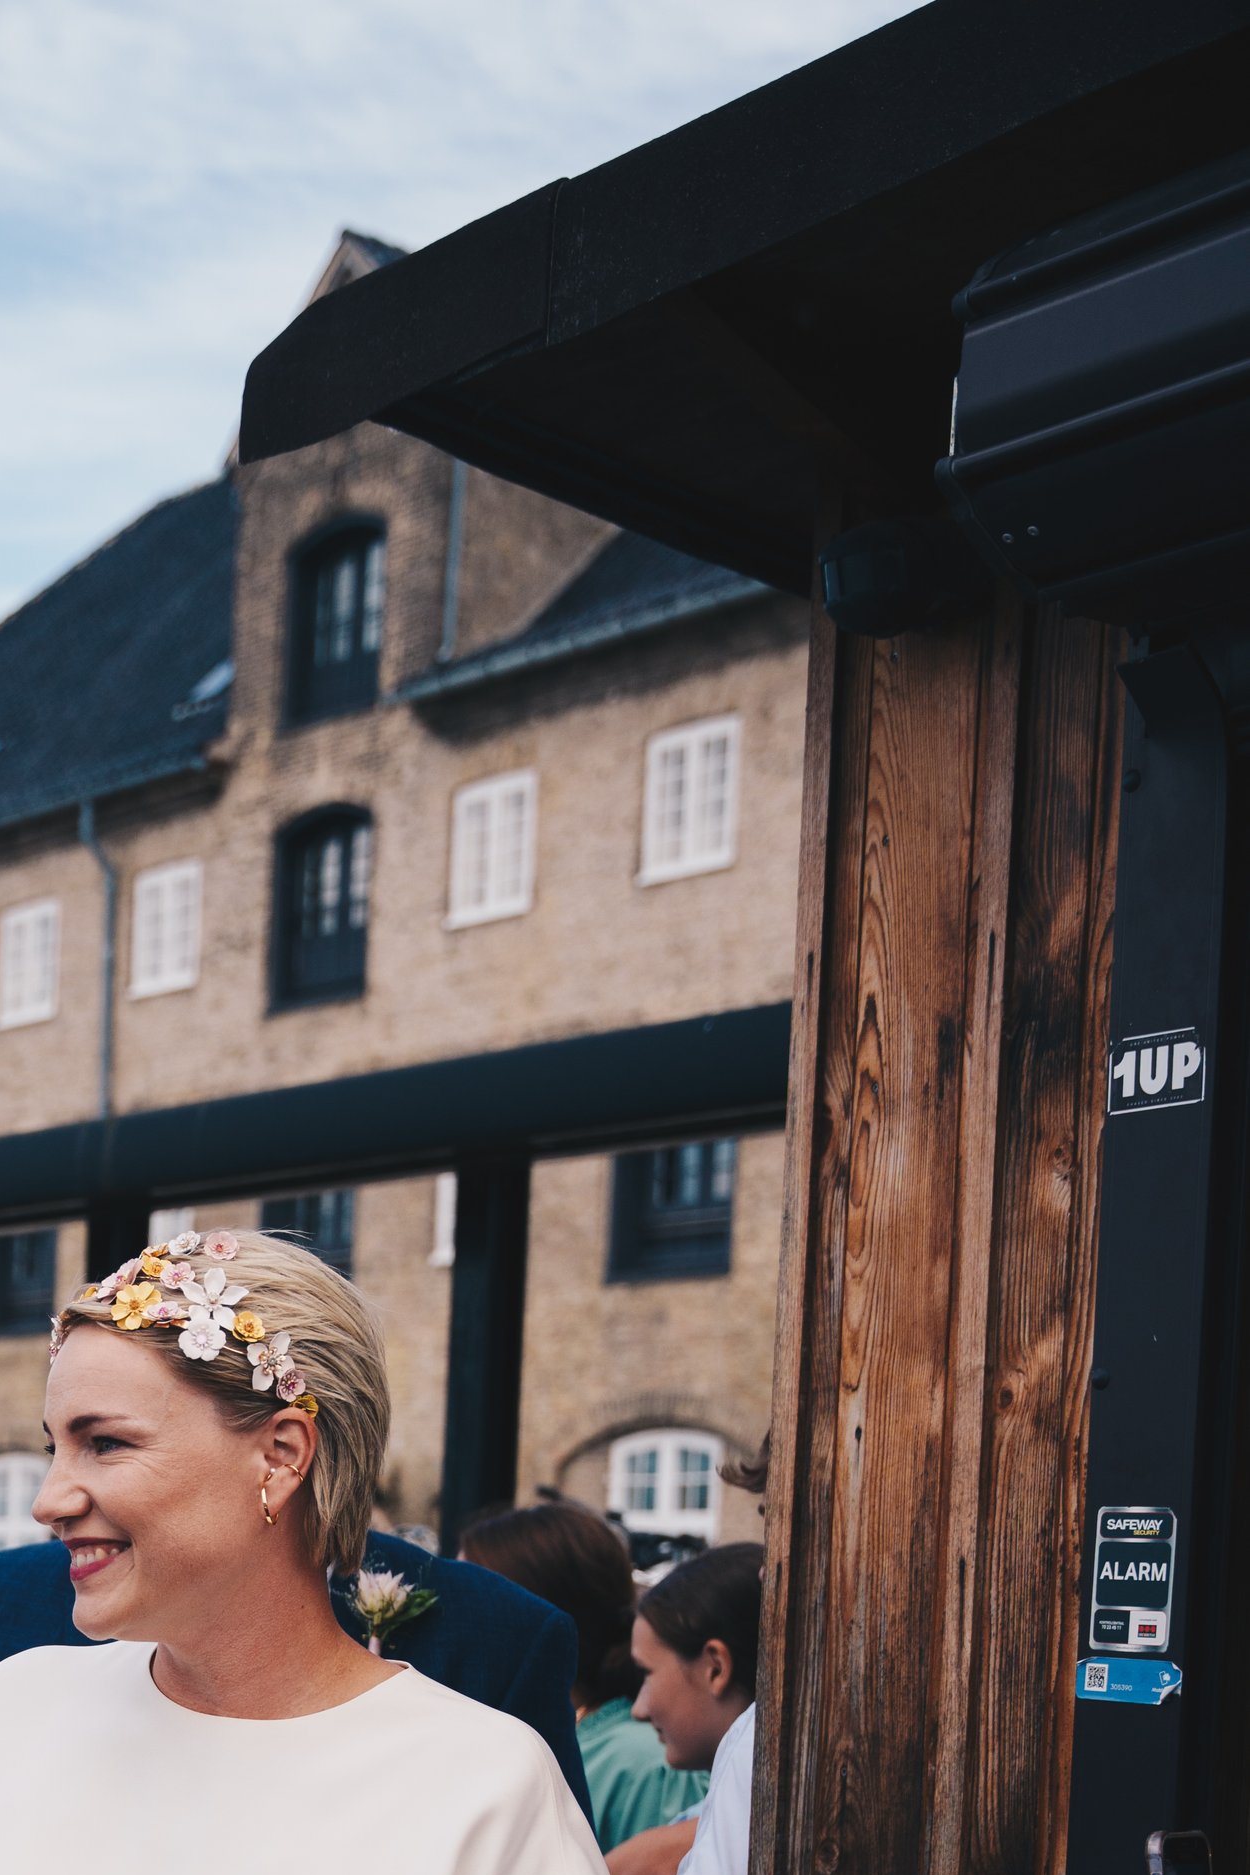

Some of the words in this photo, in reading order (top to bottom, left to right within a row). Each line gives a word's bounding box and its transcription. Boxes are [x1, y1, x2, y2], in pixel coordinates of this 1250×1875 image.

[1113, 1041, 1201, 1098] 1UP
[1106, 1518, 1163, 1531] SAFEWAY
[1099, 1561, 1167, 1582] ALARM
